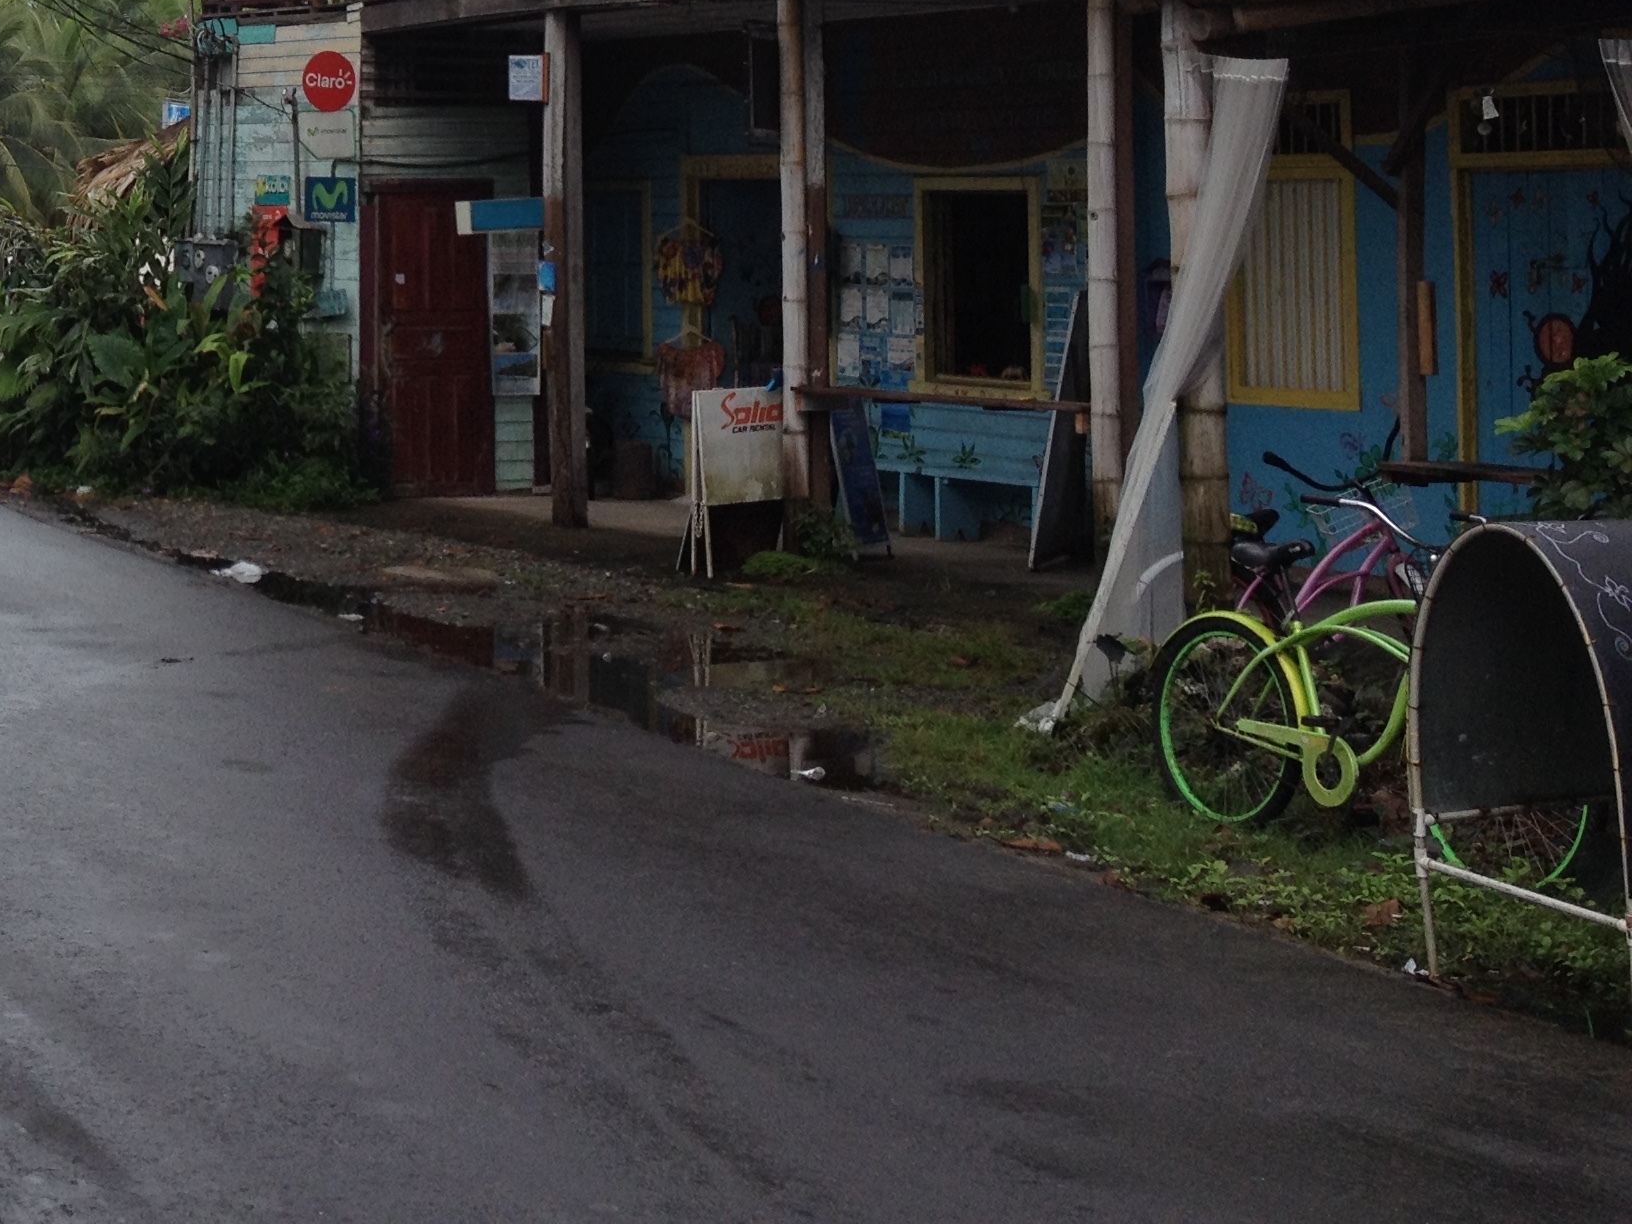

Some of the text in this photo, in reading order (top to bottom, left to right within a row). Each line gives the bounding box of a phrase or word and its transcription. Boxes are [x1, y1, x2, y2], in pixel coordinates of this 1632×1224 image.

[305, 70, 346, 90] Claro
[310, 211, 348, 220] movistar
[732, 423, 777, 434] CAR RENTAL
